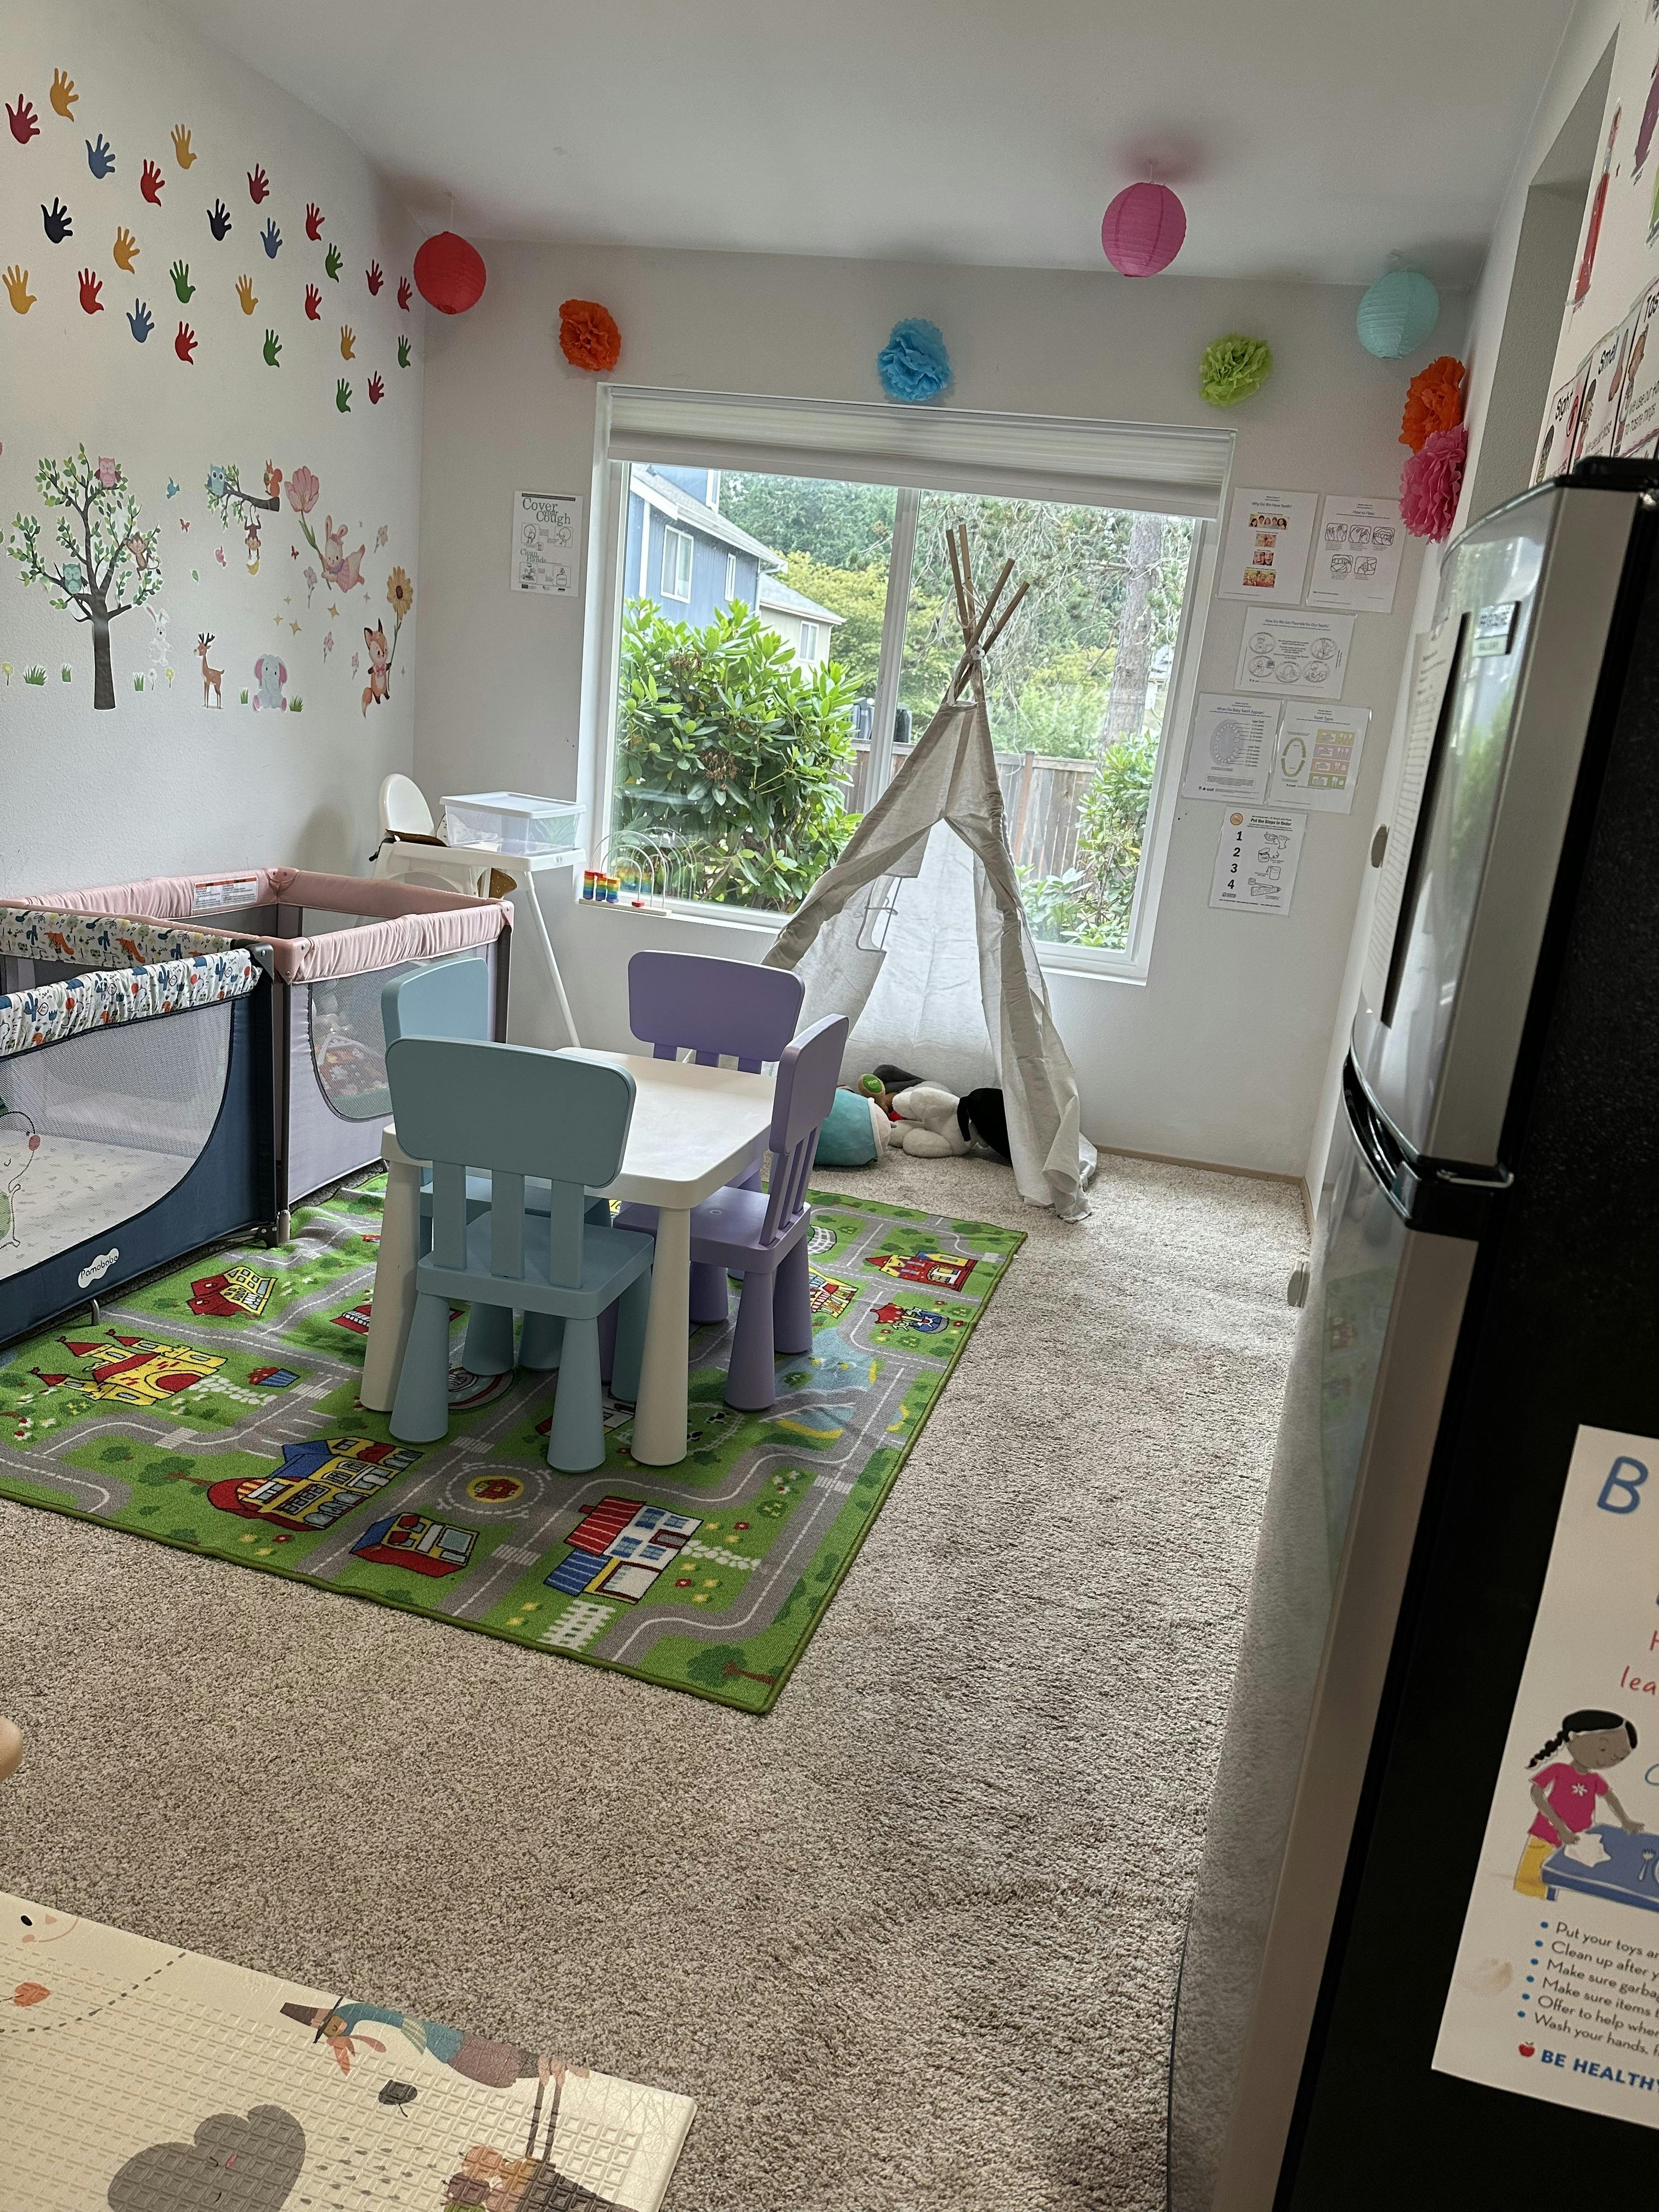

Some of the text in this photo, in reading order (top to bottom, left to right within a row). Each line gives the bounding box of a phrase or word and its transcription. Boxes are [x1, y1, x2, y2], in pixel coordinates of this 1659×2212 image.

[1555, 387, 1573, 422] Sight
[522, 497, 558, 511] Cover
[536, 510, 571, 527] Cough
[1236, 831, 1243, 841] 1
[1233, 847, 1241, 857] 2
[1231, 863, 1238, 873] 3
[1227, 879, 1235, 889] 4
[81, 1255, 118, 1279] Pamobabe
[1597, 1455, 1649, 1515] B
[1620, 1665, 1656, 1695] lea
[1556, 1922, 1579, 1939] Put
[1582, 1933, 1612, 1947] your
[1616, 1939, 1643, 1956] toys
[1551, 1940, 1593, 1962] Clean
[1596, 1957, 1613, 1969] up
[1616, 1959, 1649, 1976] after
[1547, 1959, 1585, 1980] Make
[1588, 1974, 1617, 1988] sure
[1542, 1977, 1651, 2017] Make sure items
[1538, 1995, 1575, 2014] Offer
[1579, 2007, 1593, 2019] to
[1595, 2009, 1624, 2030] help
[1535, 2012, 1571, 2034] Wash
[1574, 2028, 1604, 2039] your
[1607, 2032, 1649, 2055] hands.
[1541, 2049, 1566, 2068] BE
